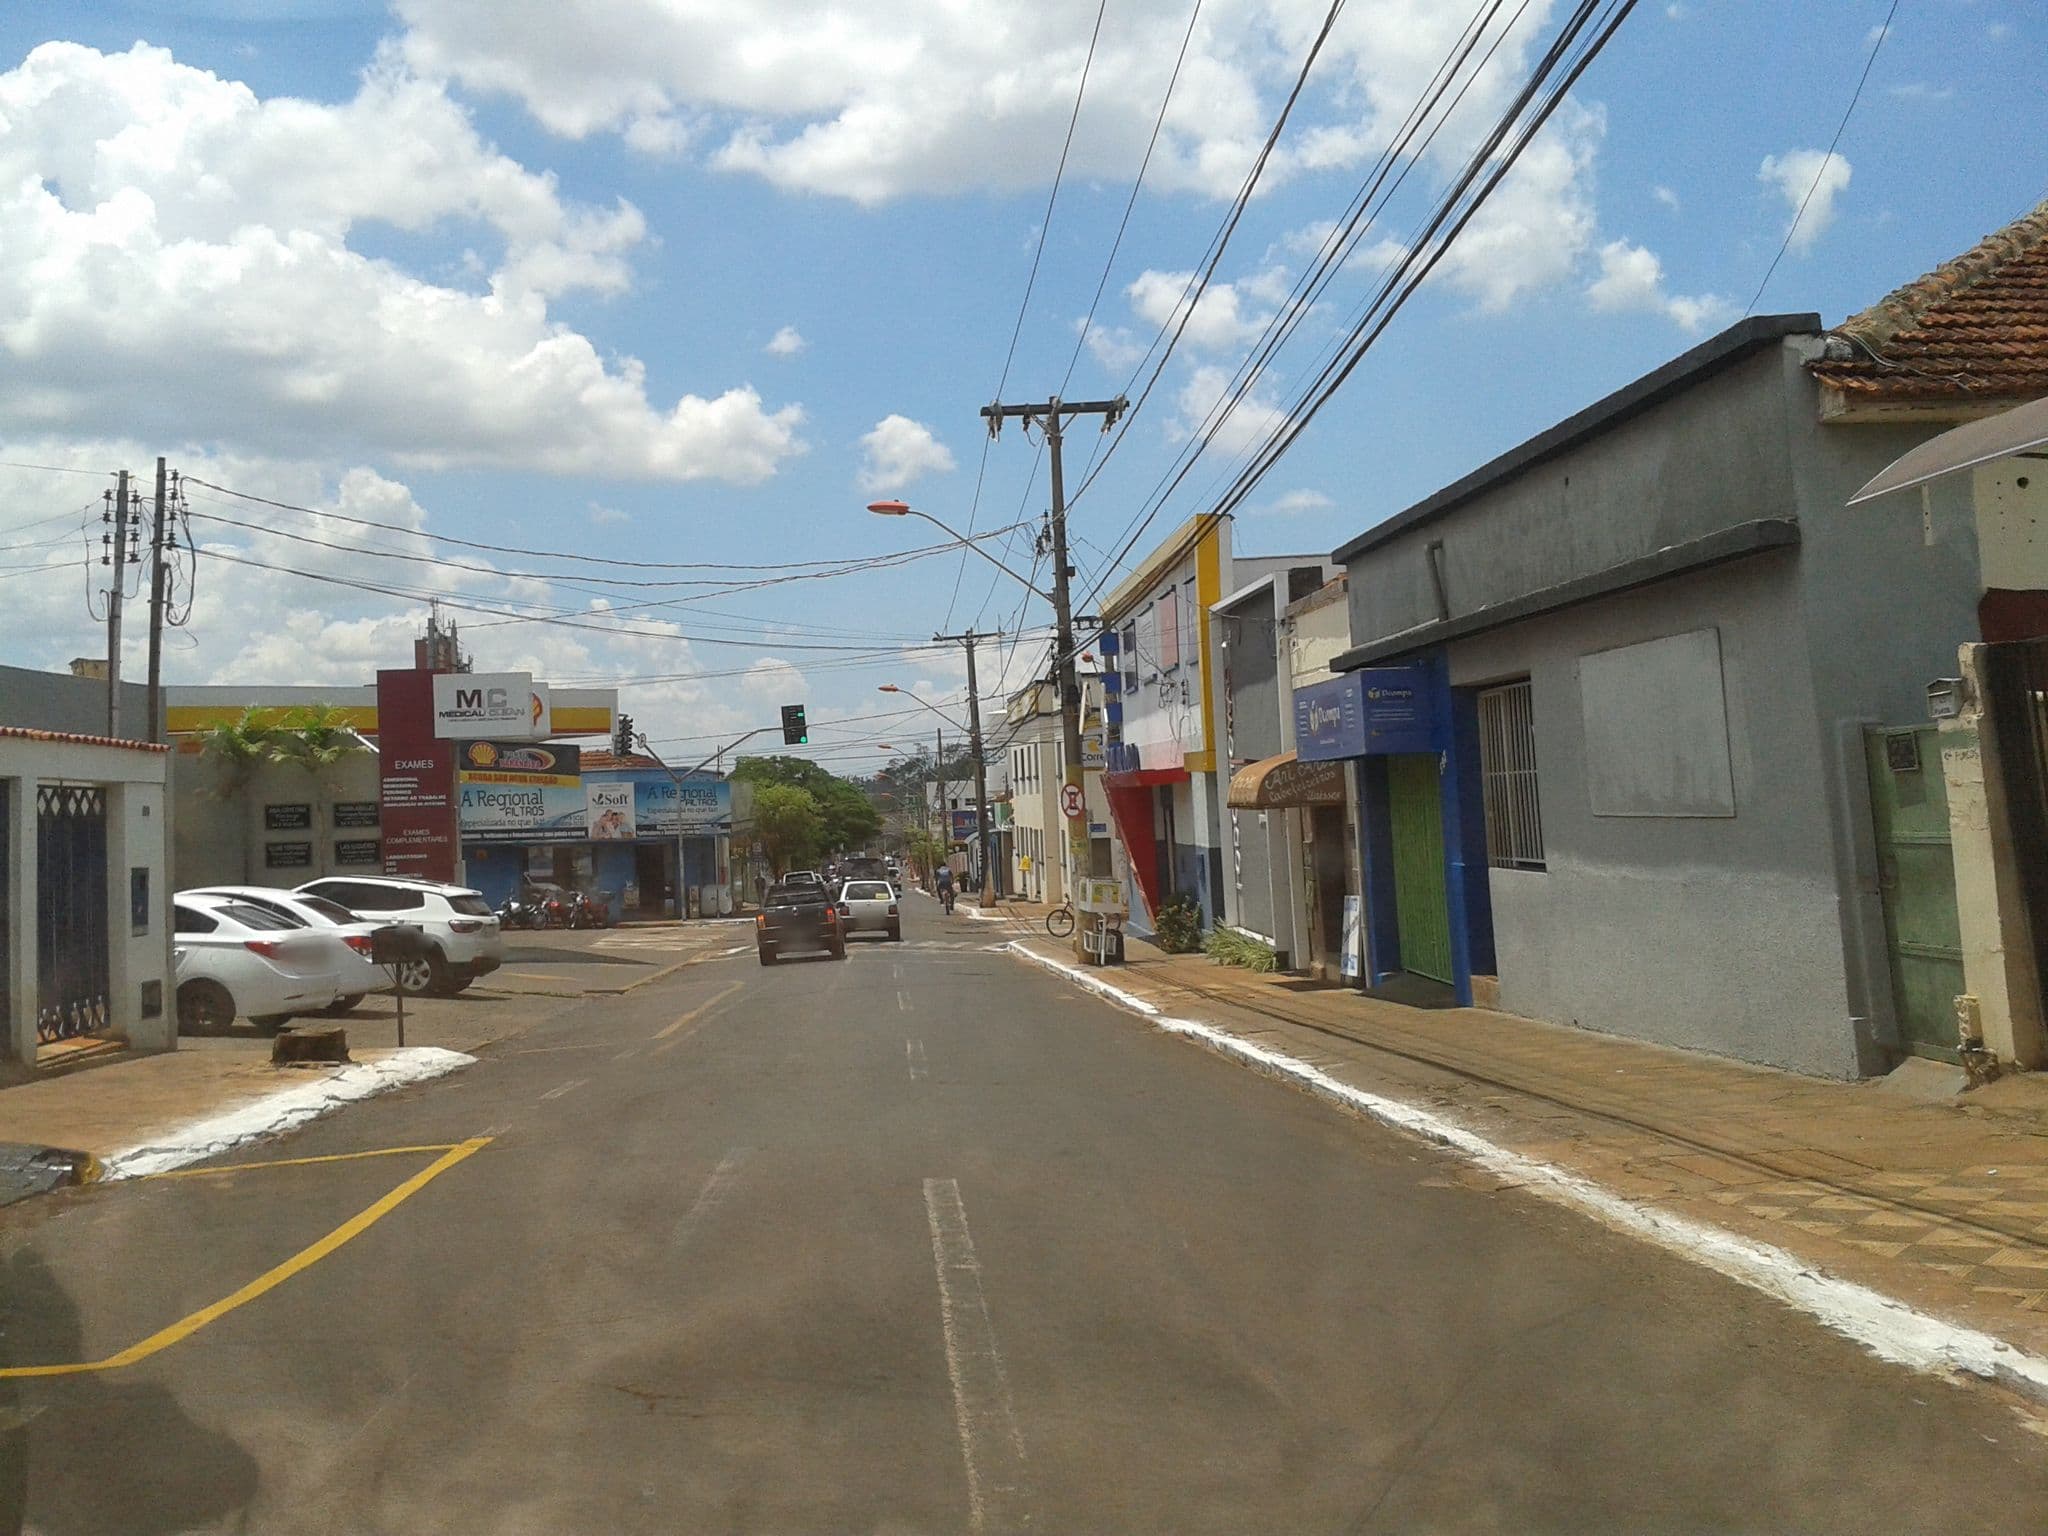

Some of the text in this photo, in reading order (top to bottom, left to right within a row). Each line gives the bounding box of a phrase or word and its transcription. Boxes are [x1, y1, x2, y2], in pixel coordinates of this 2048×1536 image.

[439, 709, 485, 718] MEDICAL
[395, 760, 434, 770] EXAMES
[604, 793, 629, 805] Soft
[647, 786, 658, 800] A
[461, 788, 544, 811] A Regional
[505, 805, 545, 817] FILTROS
